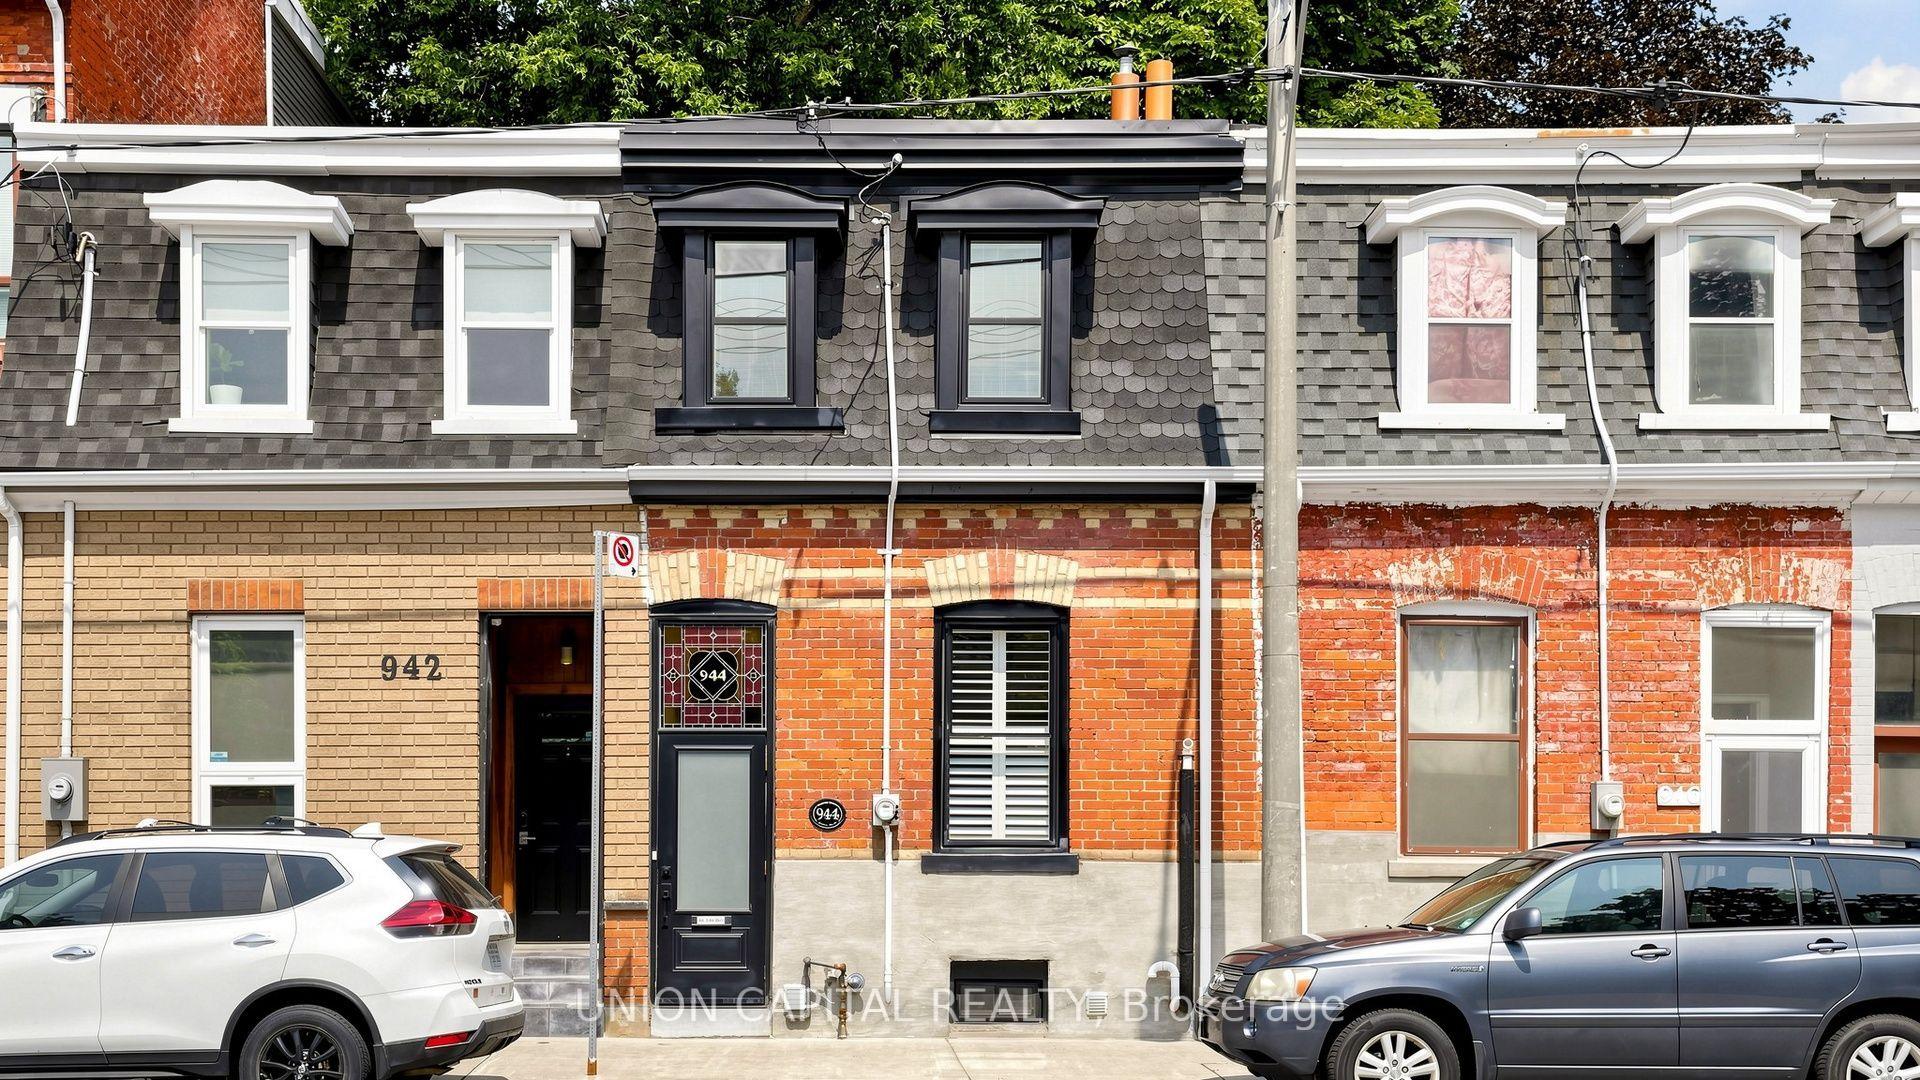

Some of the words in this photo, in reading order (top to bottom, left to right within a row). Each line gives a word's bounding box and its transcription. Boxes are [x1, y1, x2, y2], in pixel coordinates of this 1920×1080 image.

[381, 654, 442, 681] 942
[699, 669, 727, 682] 944
[816, 807, 840, 820] 944
